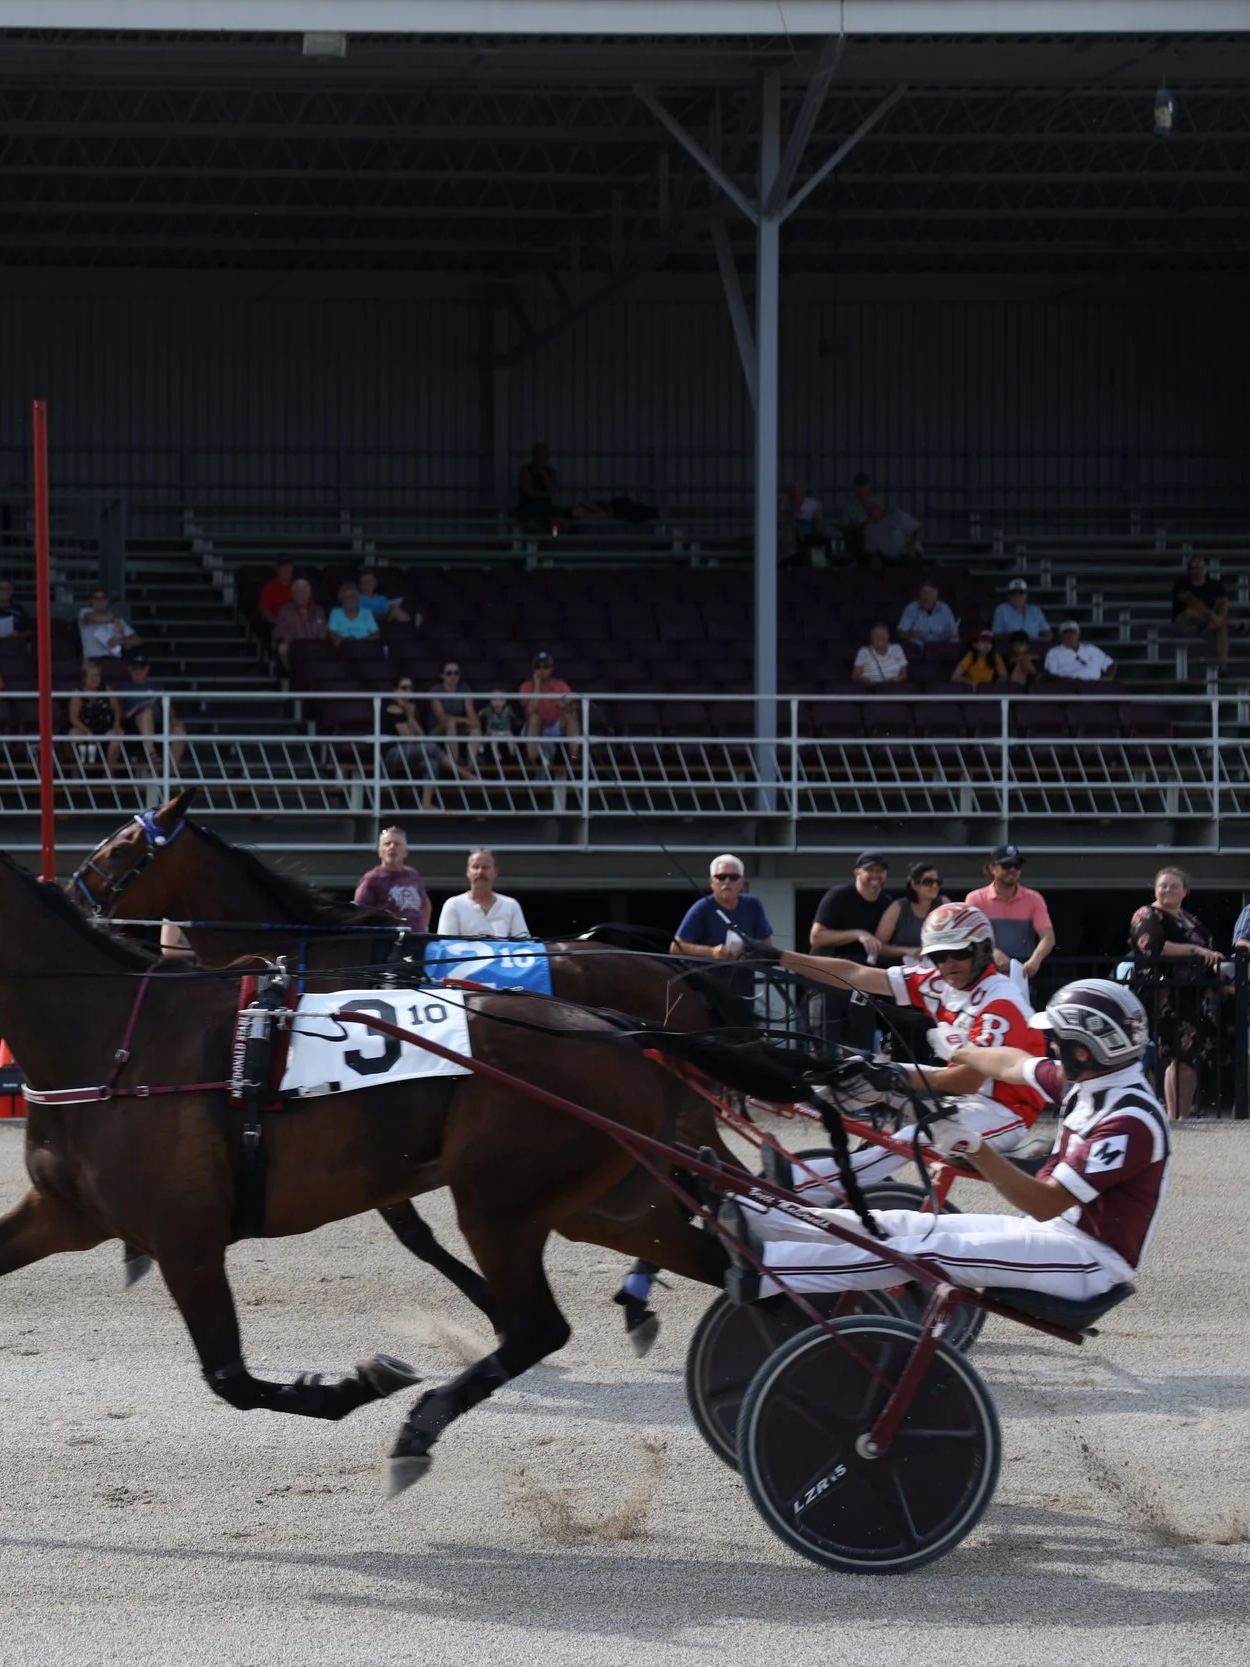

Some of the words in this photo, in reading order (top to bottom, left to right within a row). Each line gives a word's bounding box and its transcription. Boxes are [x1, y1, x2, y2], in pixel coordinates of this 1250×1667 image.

[445, 940, 496, 990] 2
[498, 947, 536, 969] 10
[338, 998, 403, 1076] 3
[407, 1003, 448, 1026] 10
[1093, 1141, 1127, 1166] M
